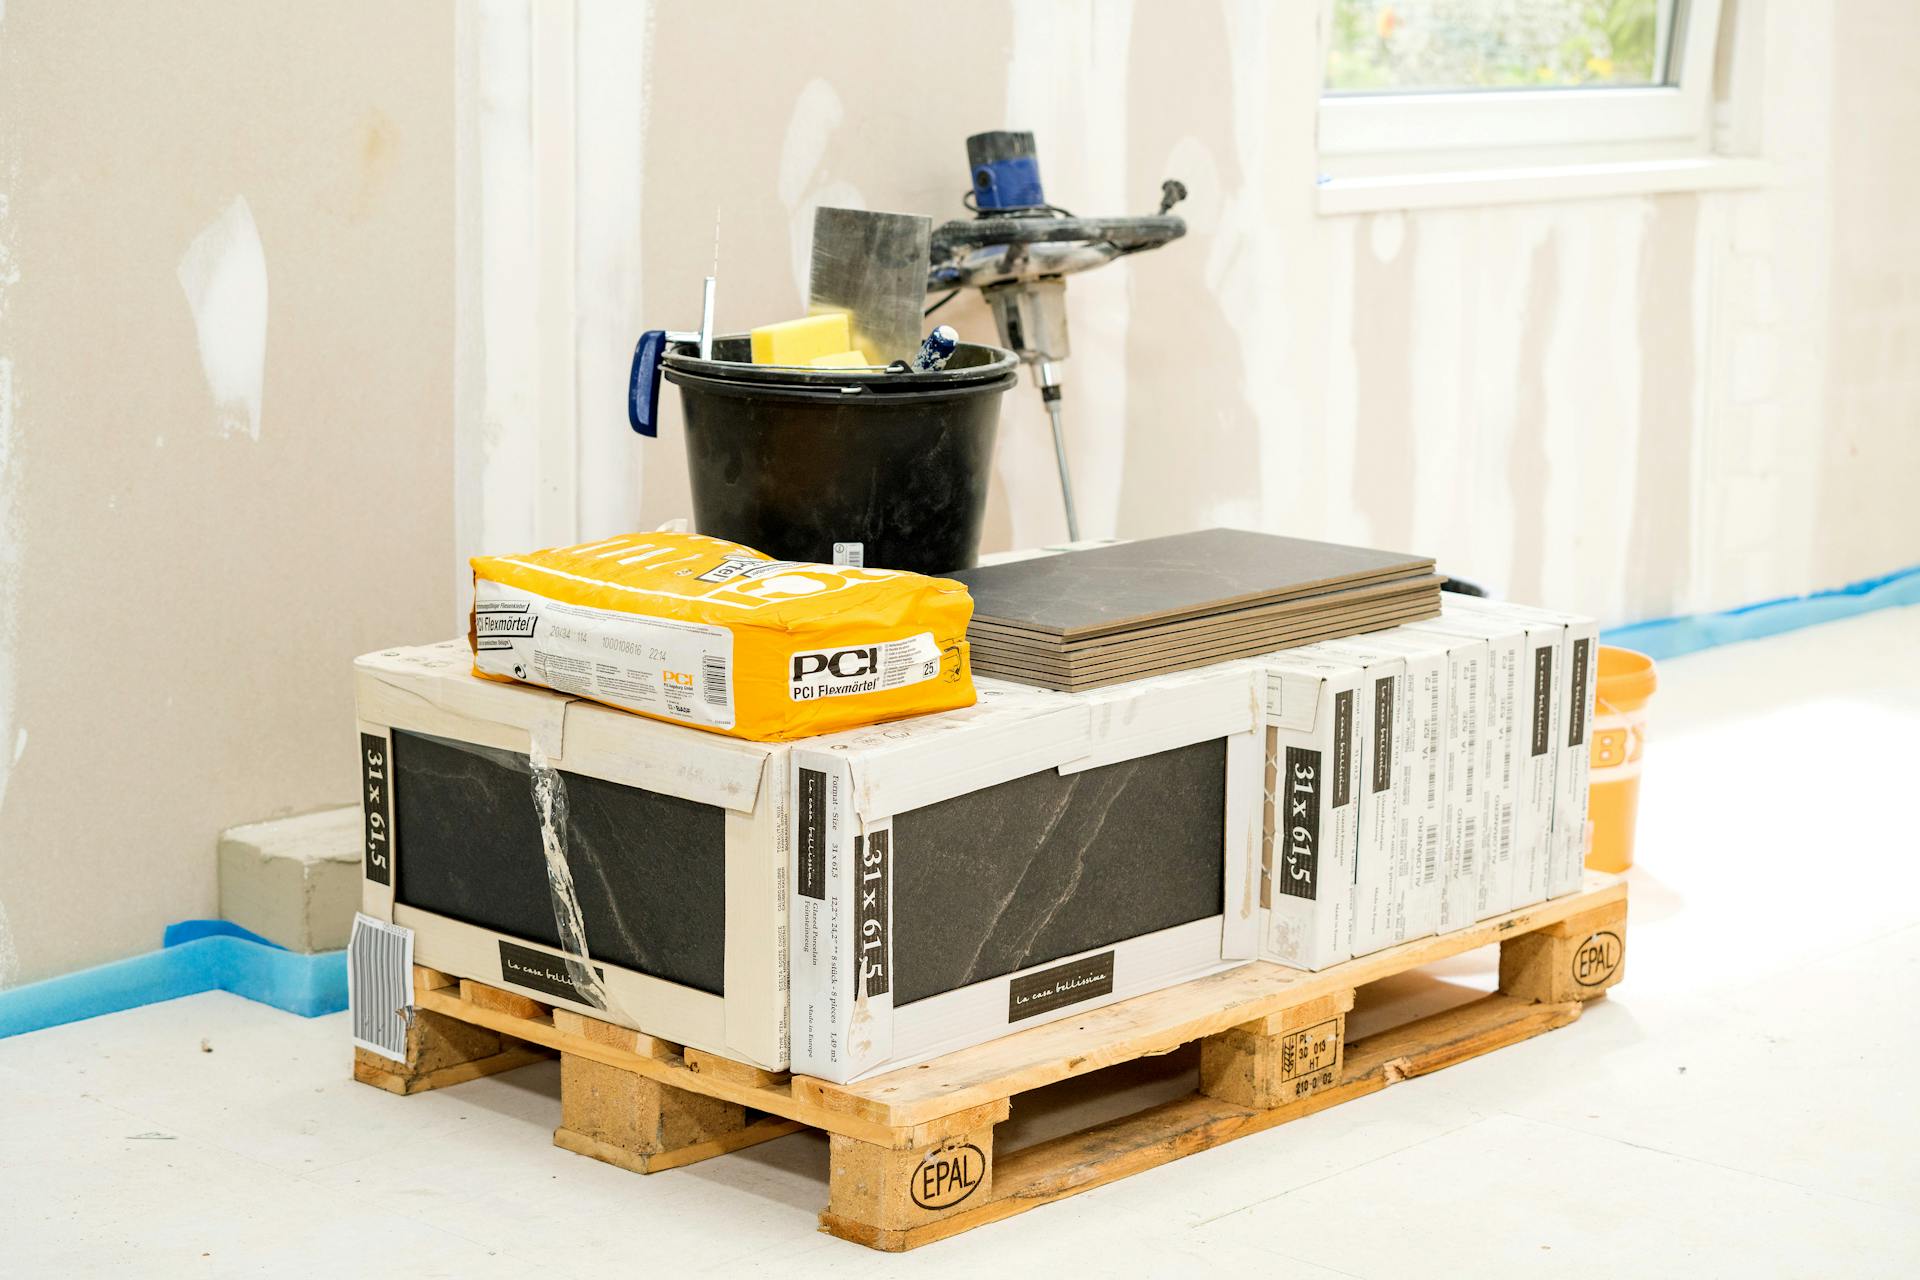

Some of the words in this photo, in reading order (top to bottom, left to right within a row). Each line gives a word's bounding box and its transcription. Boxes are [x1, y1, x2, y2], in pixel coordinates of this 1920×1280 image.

[485, 615, 530, 631] Flexmörtel
[663, 671, 693, 686] PCI
[793, 647, 878, 682] PCI
[924, 661, 934, 676] 25
[794, 686, 814, 700] PCI
[818, 678, 876, 698] Flexmörtel
[367, 749, 384, 780] 31
[1422, 746, 1428, 760] 1A
[1294, 763, 1315, 794] 31
[368, 811, 387, 870] 61,5
[832, 843, 838, 853] 31
[1286, 826, 1314, 884] 61,5
[863, 850, 882, 885] 31
[1580, 942, 1613, 978] EPAL
[1032, 990, 1053, 999] casa
[1056, 972, 1106, 993] bellissima
[1309, 1056, 1319, 1070] HT
[923, 1154, 976, 1200] EPAL
